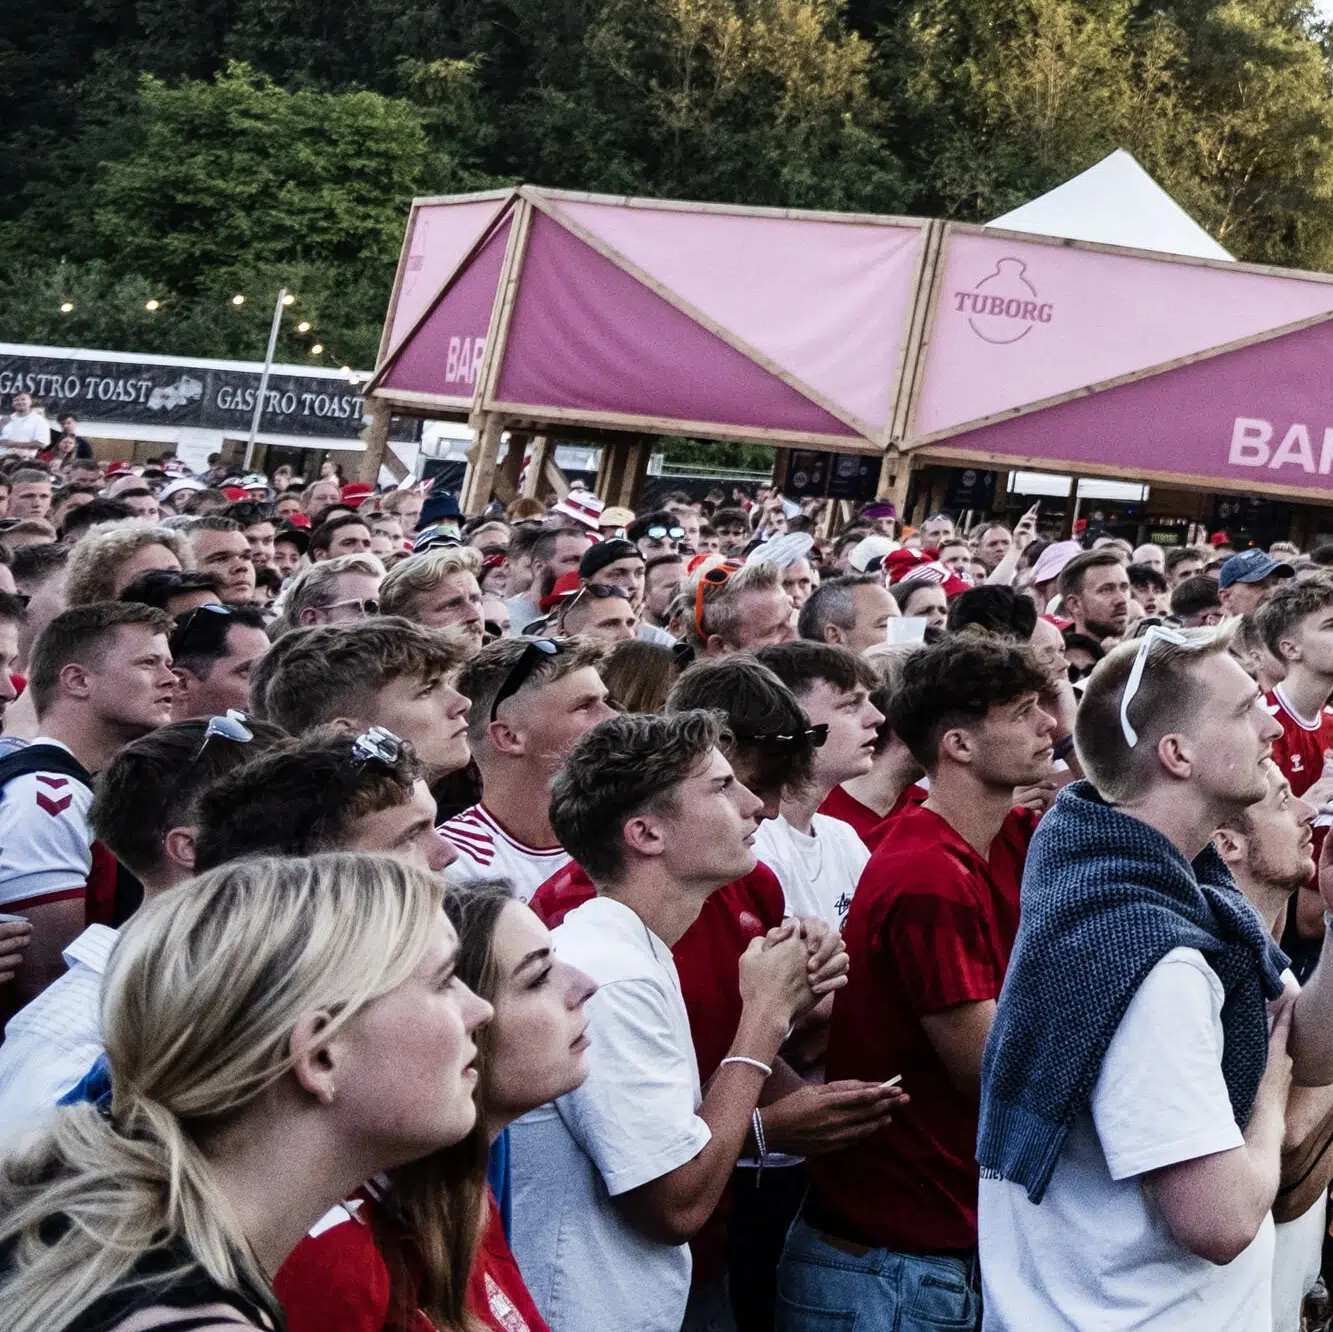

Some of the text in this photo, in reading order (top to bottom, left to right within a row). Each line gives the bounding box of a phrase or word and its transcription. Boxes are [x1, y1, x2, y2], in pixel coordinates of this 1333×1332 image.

[954, 291, 1054, 324] TUBORG
[445, 335, 488, 385] BAR
[0, 372, 152, 405] GASTRO TOAST
[301, 394, 365, 419] TOAST
